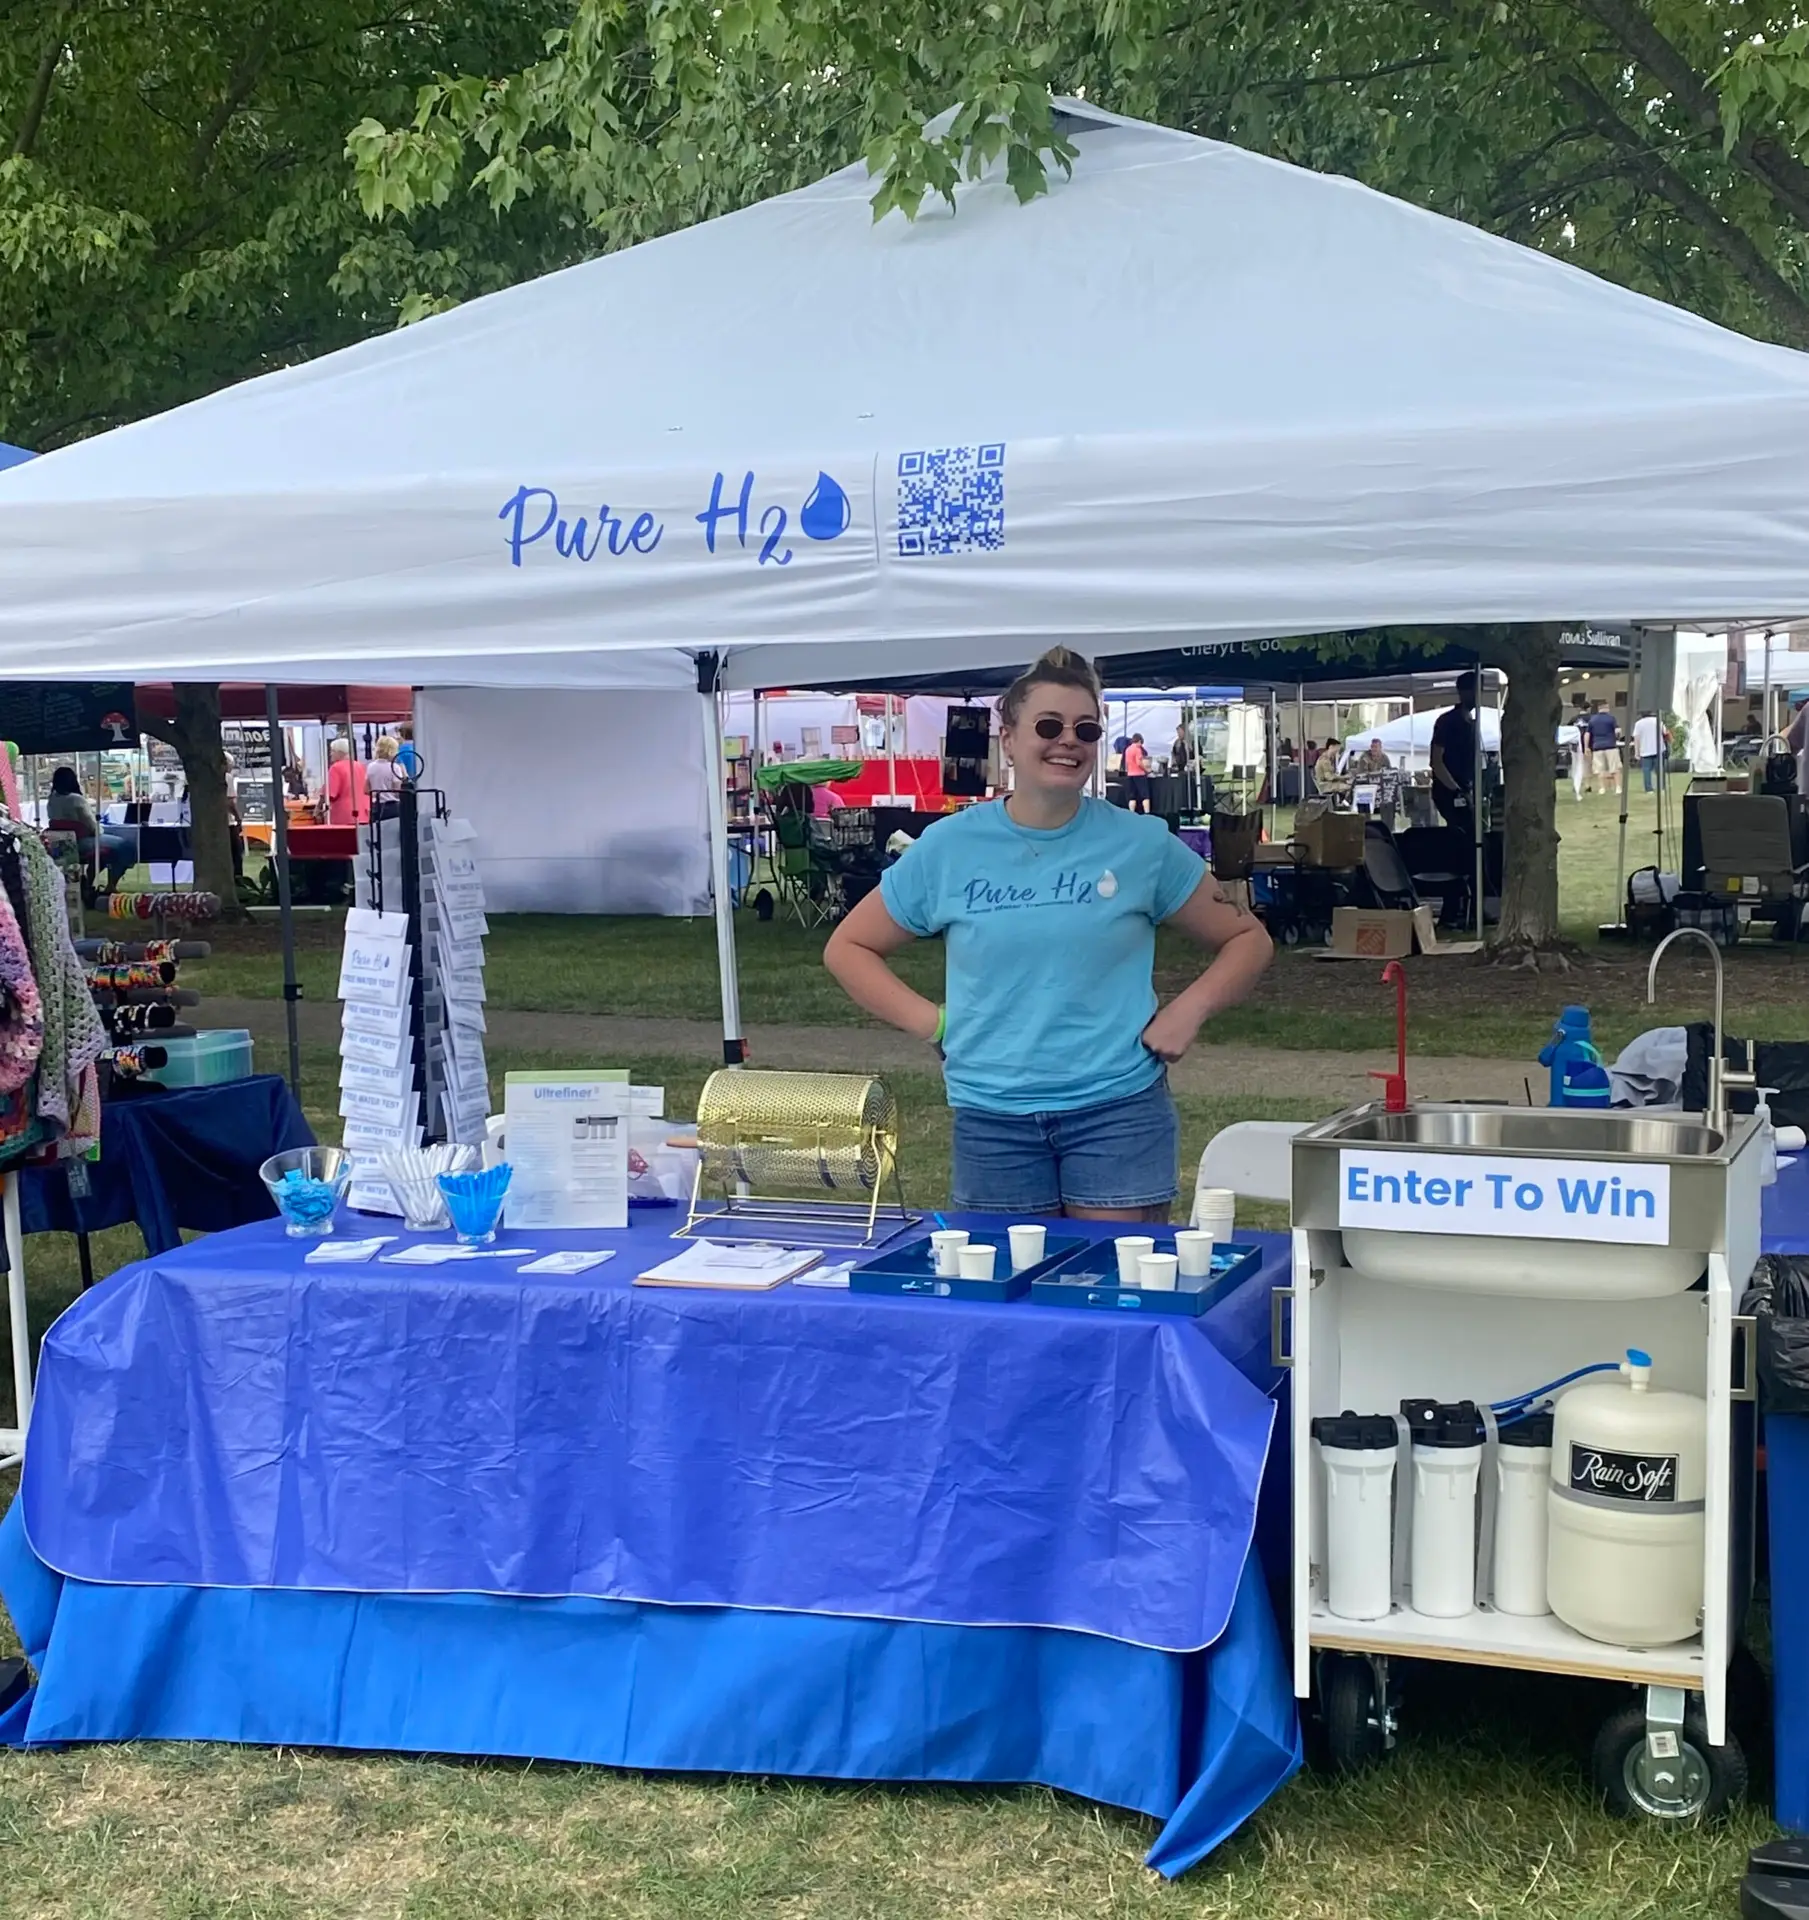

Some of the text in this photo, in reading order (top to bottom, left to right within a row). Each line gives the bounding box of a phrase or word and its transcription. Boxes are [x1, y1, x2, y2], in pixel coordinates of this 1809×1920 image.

[498, 484, 663, 567] Pure
[964, 878, 1036, 909] Pure
[1347, 1166, 1656, 1219] Enter To Win
